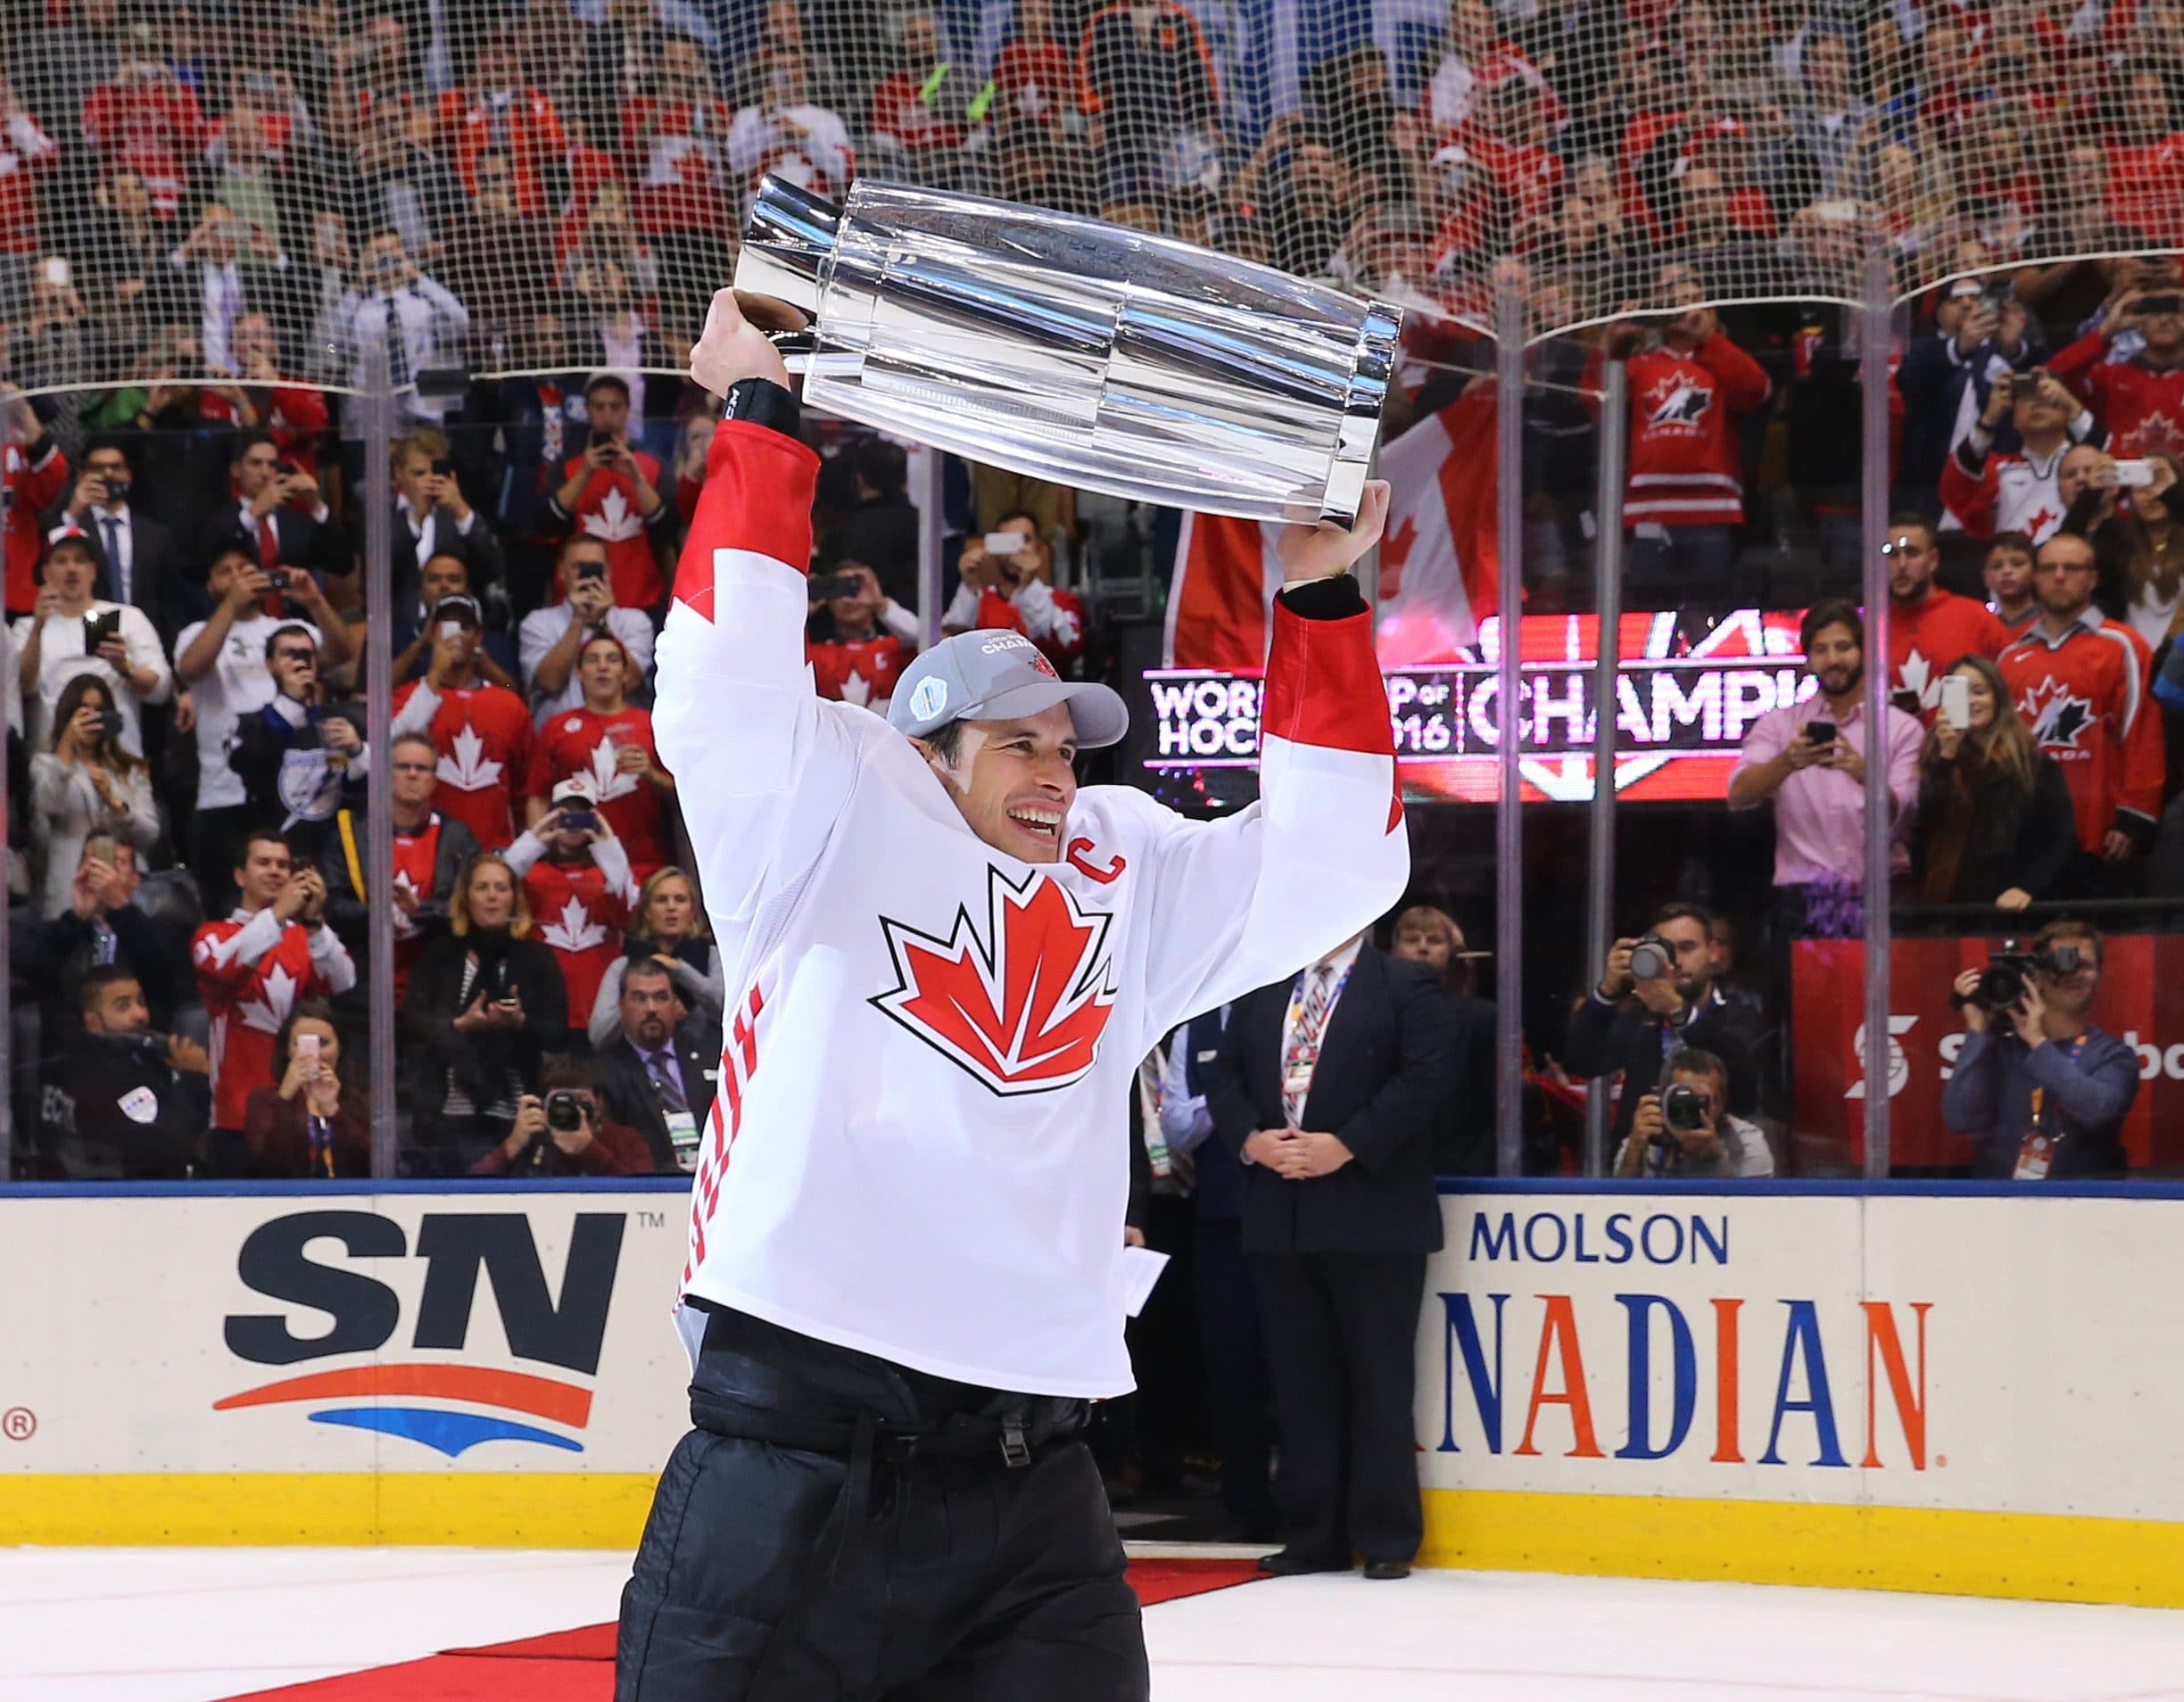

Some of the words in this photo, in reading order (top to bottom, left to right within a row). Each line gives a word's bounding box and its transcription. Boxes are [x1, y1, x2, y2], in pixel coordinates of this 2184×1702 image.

[1151, 680, 1265, 719] WOR
[1159, 716, 1262, 756] HOC
[1390, 713, 1451, 751] 16
[1066, 837, 1126, 884] C
[1469, 1212, 1728, 1264] MOLSON
[224, 1210, 627, 1376] SN
[1415, 1293, 1934, 1470] NADIAN
